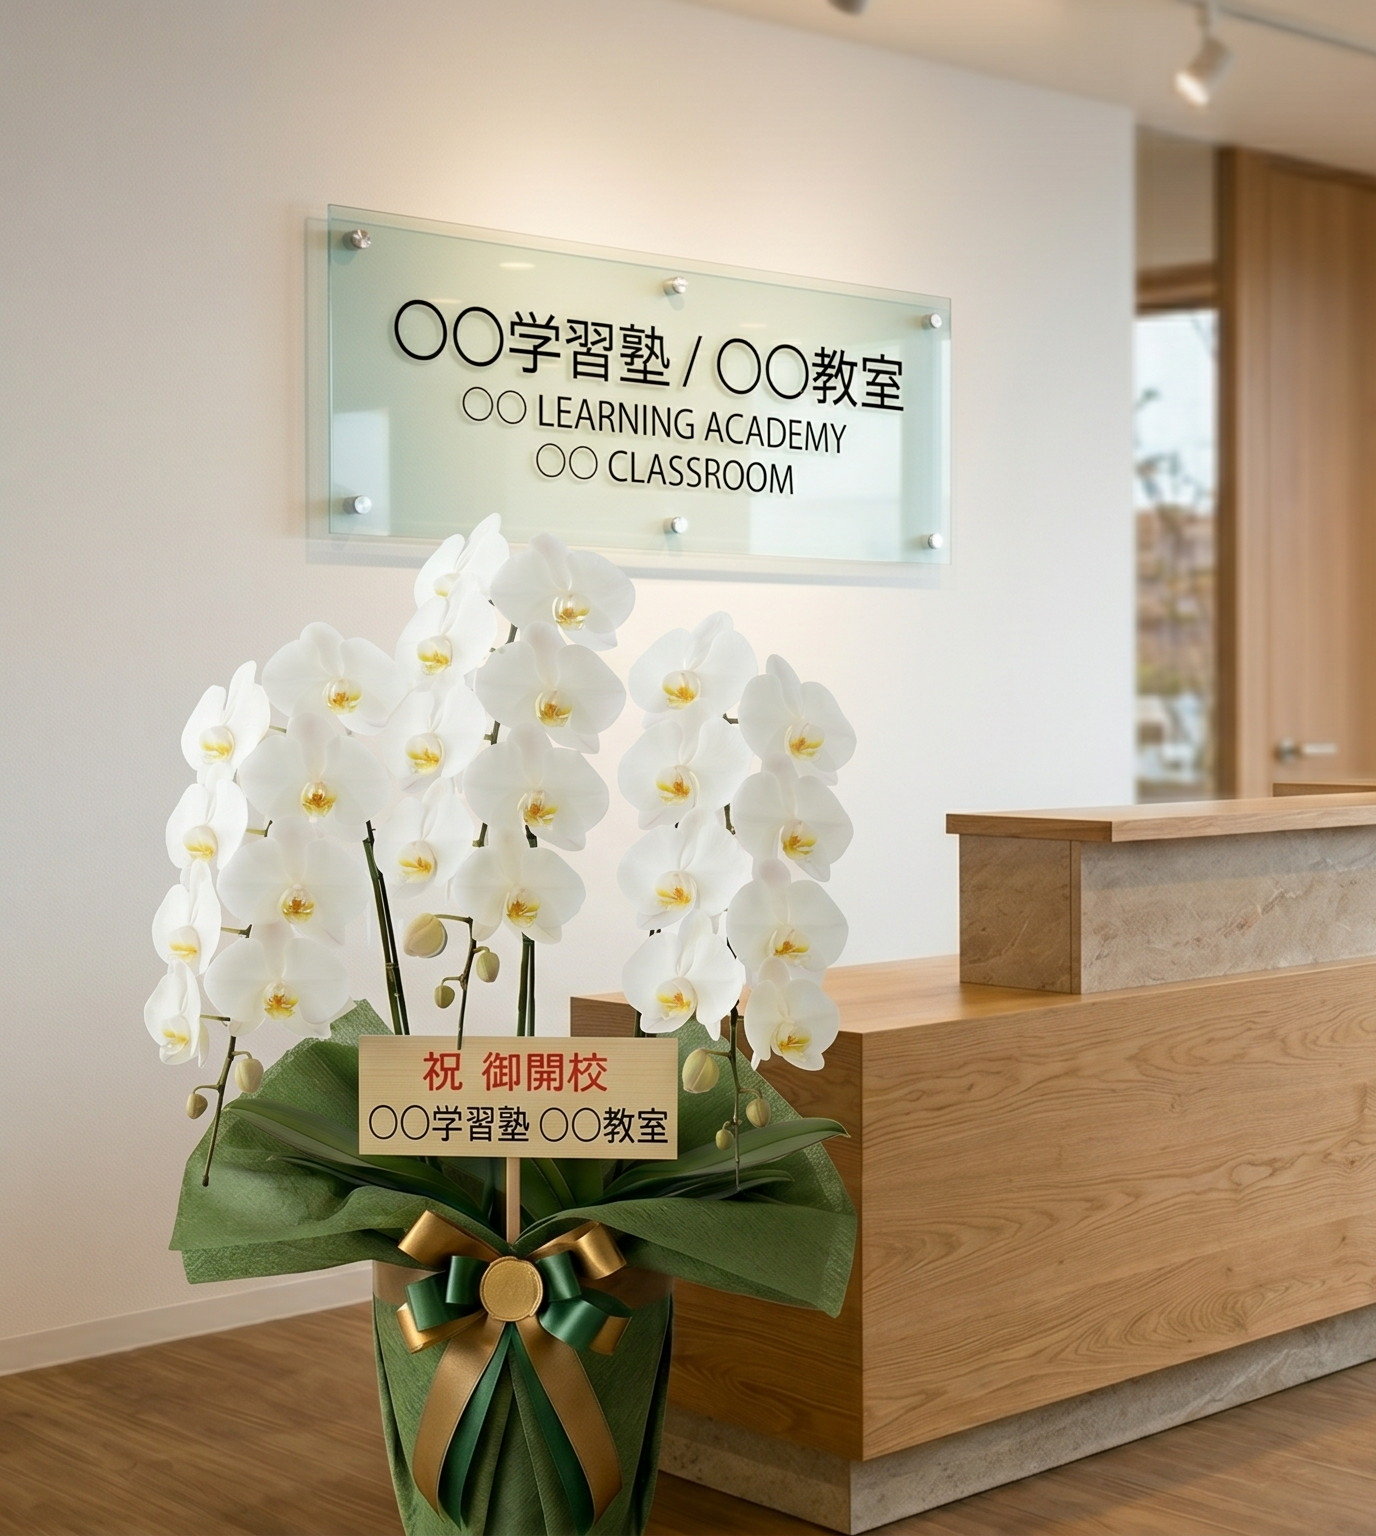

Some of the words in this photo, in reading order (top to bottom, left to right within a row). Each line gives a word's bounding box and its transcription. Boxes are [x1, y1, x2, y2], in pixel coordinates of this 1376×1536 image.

[682, 335, 703, 388] /
[538, 395, 695, 441] LEARNING
[704, 412, 847, 454] ACADEMY
[607, 450, 794, 495] CLASSROOM
[422, 1051, 463, 1091] 祝
[481, 1051, 608, 1092] 御開校
